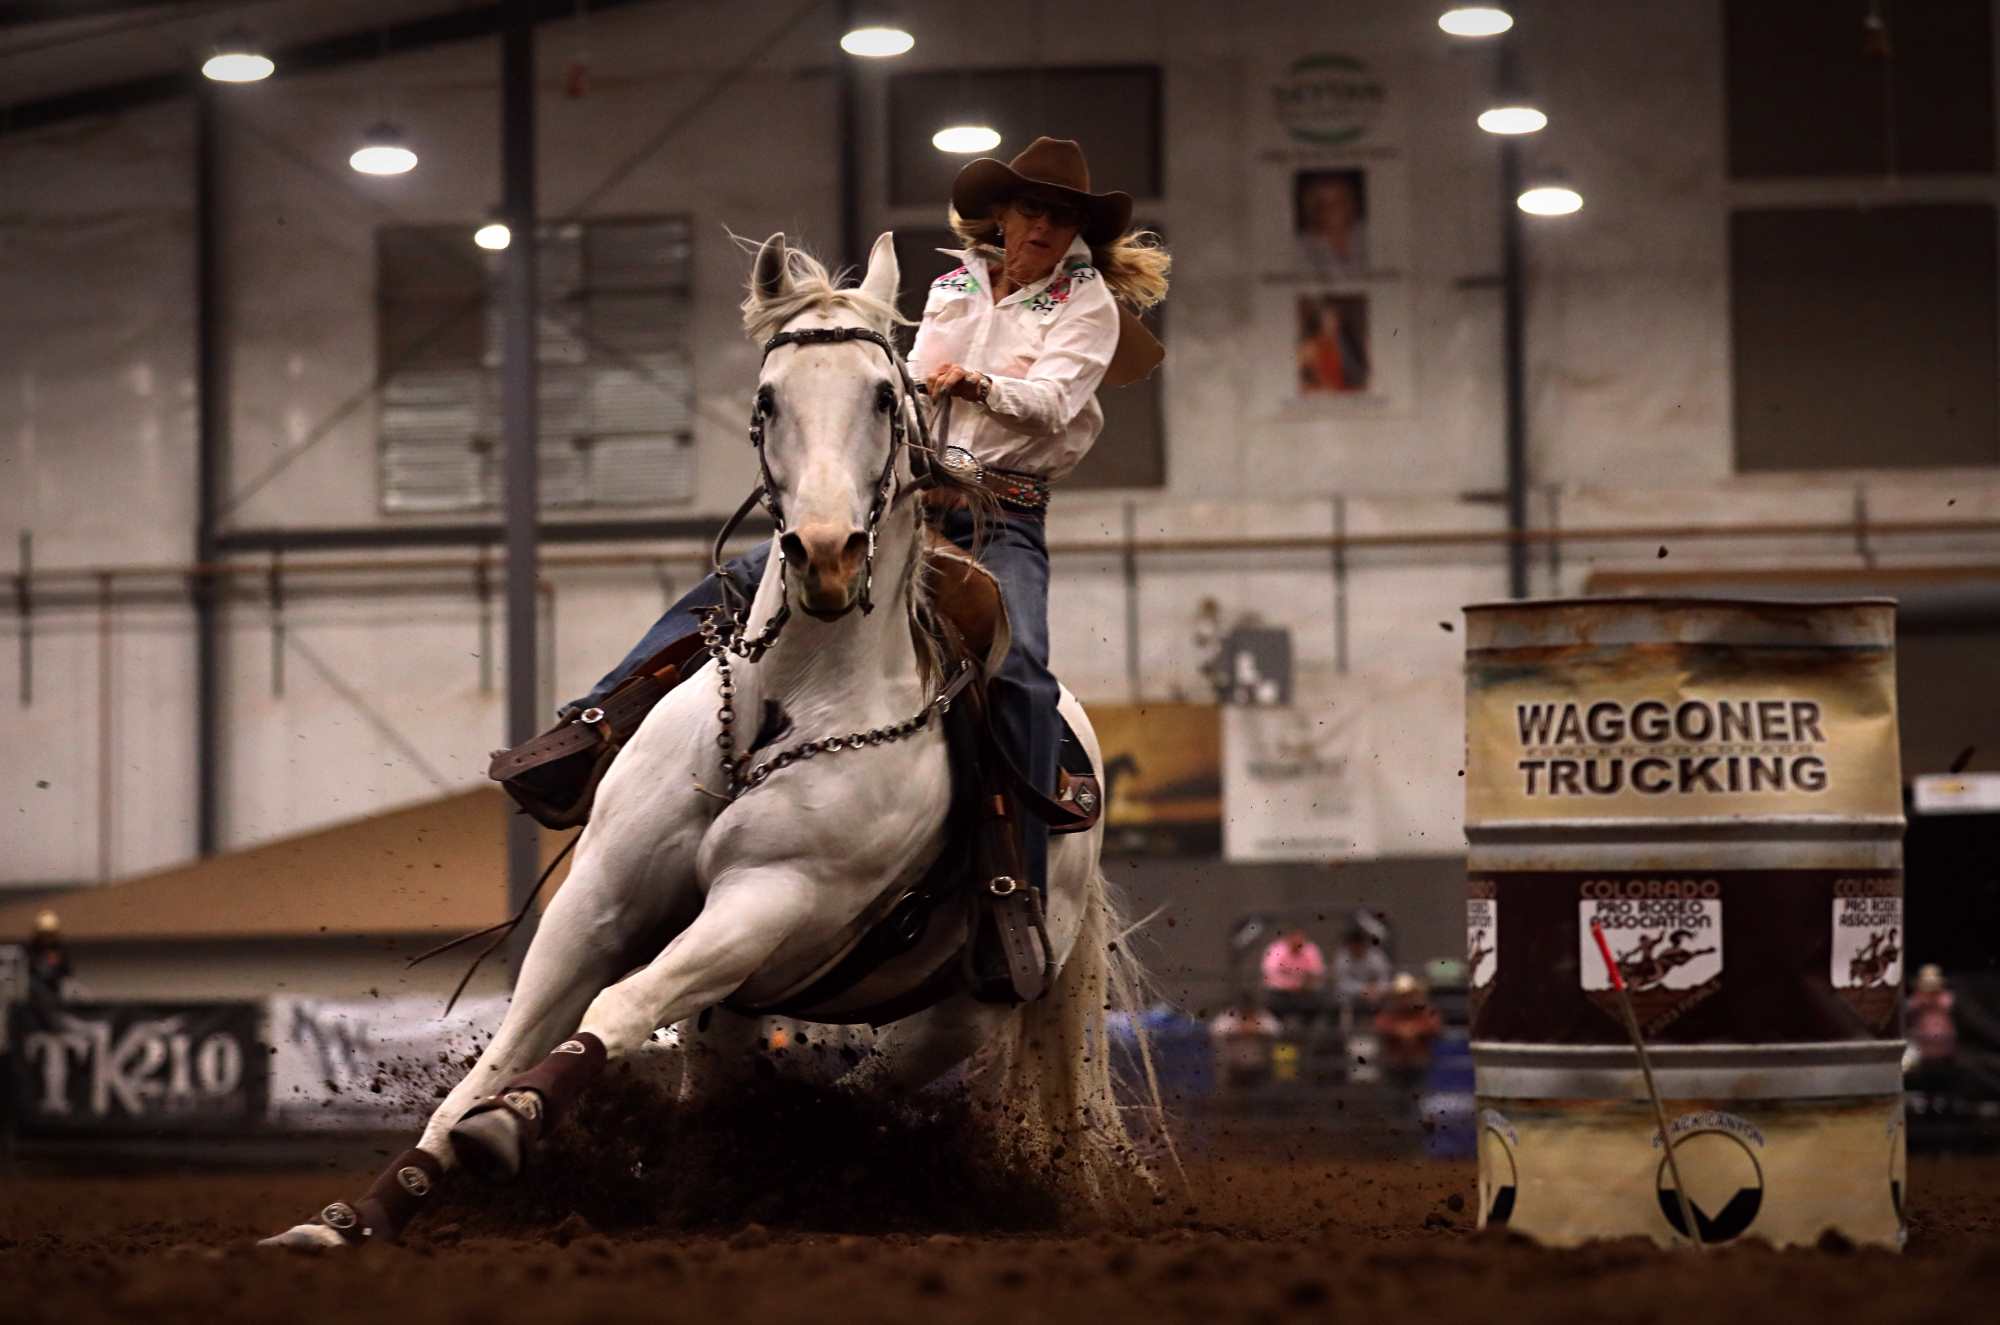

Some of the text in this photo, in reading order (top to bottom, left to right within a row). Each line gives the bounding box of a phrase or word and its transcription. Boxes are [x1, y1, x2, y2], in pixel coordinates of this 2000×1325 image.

[1517, 700, 1825, 745] WAGGONER
[1518, 755, 1827, 796] TRUCKING
[1580, 880, 1720, 898] COLORADO
[1596, 900, 1704, 914] PRO RODEO
[1590, 915, 1712, 929] ASSOCIATION
